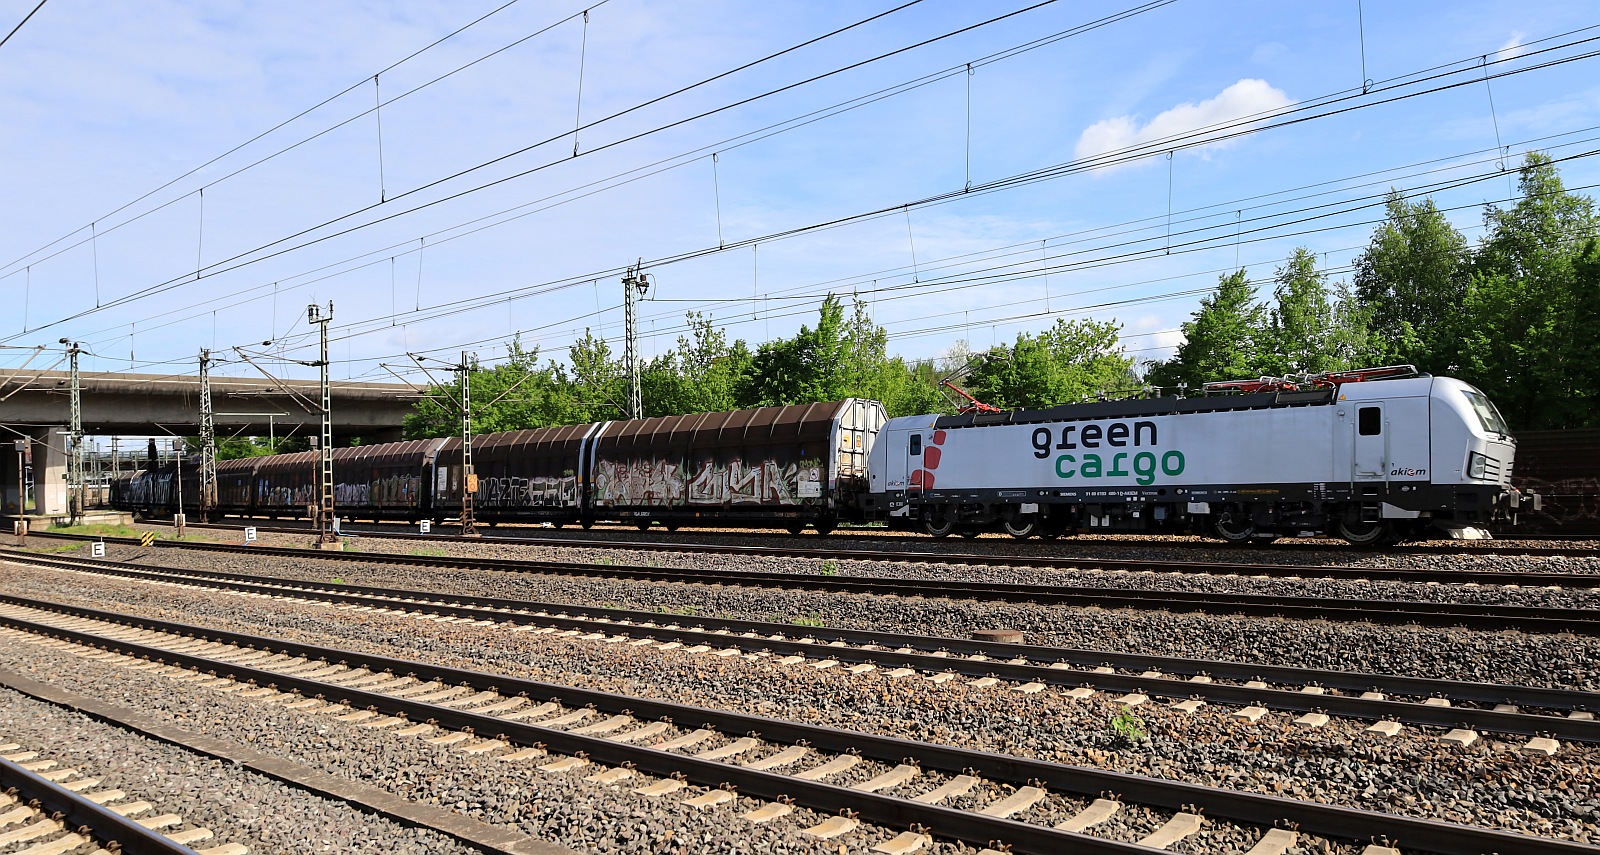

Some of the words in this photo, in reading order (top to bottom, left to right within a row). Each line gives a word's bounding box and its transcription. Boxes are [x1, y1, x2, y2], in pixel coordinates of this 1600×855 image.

[1032, 421, 1158, 459] green
[1055, 450, 1186, 485] cargo
[1390, 467, 1426, 477] akiem
[422, 521, 429, 531] E
[247, 528, 255, 540] E
[94, 543, 103, 555] E
